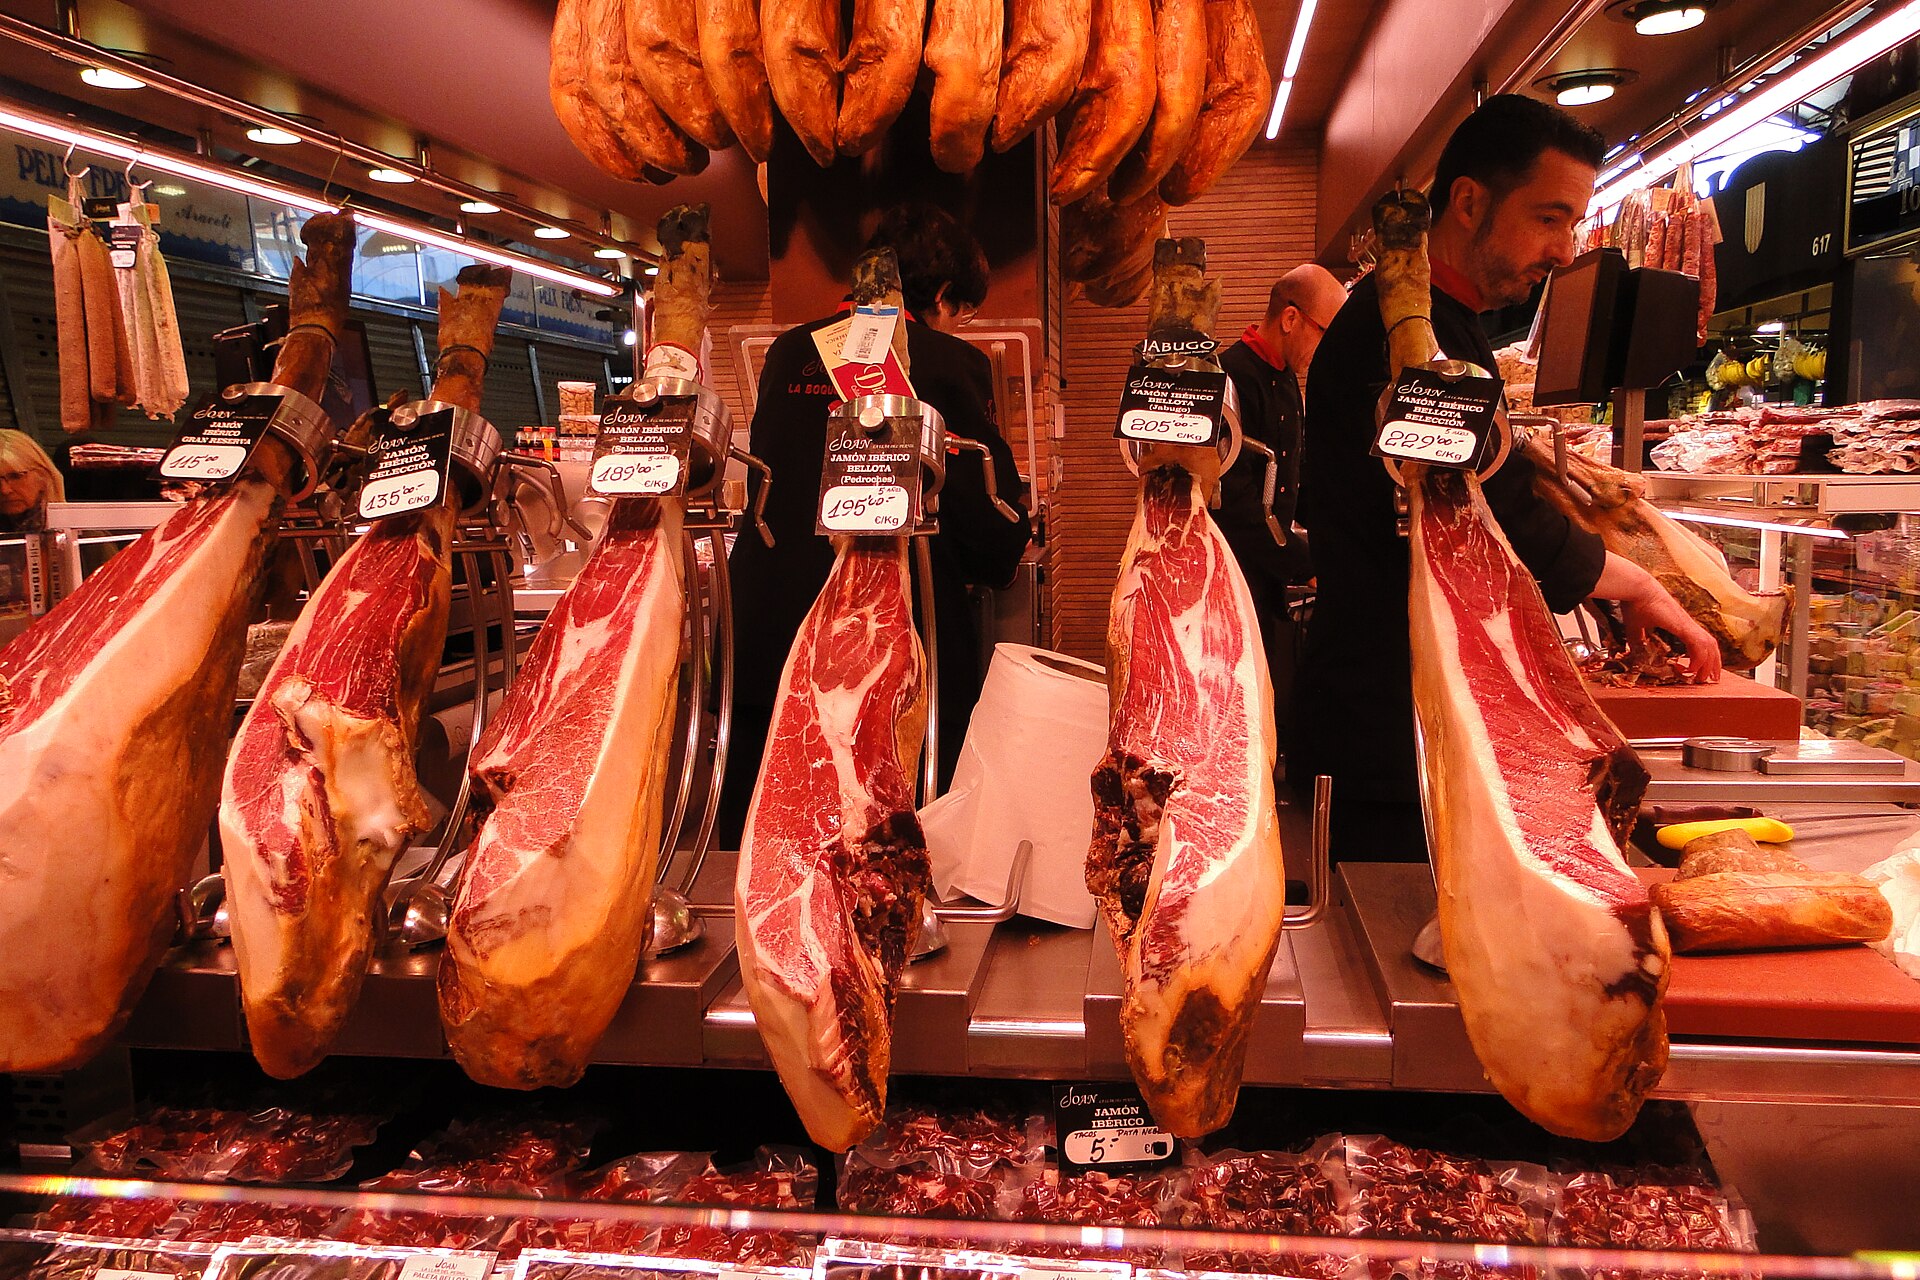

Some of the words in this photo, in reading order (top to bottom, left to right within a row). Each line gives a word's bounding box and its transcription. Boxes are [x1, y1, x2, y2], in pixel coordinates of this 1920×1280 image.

[1812, 233, 1832, 256] 617
[1142, 339, 1215, 353] JABUGO
[788, 384, 801, 394] LA
[805, 384, 837, 395] BOQU
[1131, 388, 1169, 398] JAMÓN
[1170, 392, 1214, 401] IBÉRICO
[1147, 397, 1195, 407] BELLOTA
[1397, 395, 1437, 407] JAMÓN
[1438, 401, 1484, 413] IBÉRICO
[1149, 404, 1191, 414] (Jabugo)
[1413, 406, 1462, 419] BELLOTA
[209, 421, 244, 429] JAMÓN
[1404, 413, 1466, 427] SELECCIÓN
[202, 428, 241, 437] IBÉRICO
[604, 425, 640, 434] JAMÓN
[642, 425, 684, 434] IBÉRICO
[181, 436, 209, 444] GRAN
[208, 437, 251, 445] RESERVA
[1176, 432, 1202, 441] €/Kg
[383, 445, 427, 460] JAMÓN
[611, 445, 669, 454] (Salamanca)
[1435, 449, 1463, 461] €/Kg
[378, 453, 430, 469] IBÉRICO
[830, 451, 867, 462] JAMÓN
[868, 451, 910, 462] IBÉRICO
[369, 459, 437, 480] SELECCIÓN
[847, 464, 892, 473] BELLOTA
[644, 480, 669, 489] €/Kg
[840, 475, 896, 485] (Pedroches)
[878, 487, 885, 495] 5
[407, 495, 430, 505] €/Kg
[874, 515, 899, 526] €/Kg
[1094, 1105, 1140, 1117] JAMÓN
[1091, 1117, 1145, 1129] IBÉRICO
[1074, 1131, 1098, 1139] TACOS
[1116, 1129, 1139, 1137] PATA
